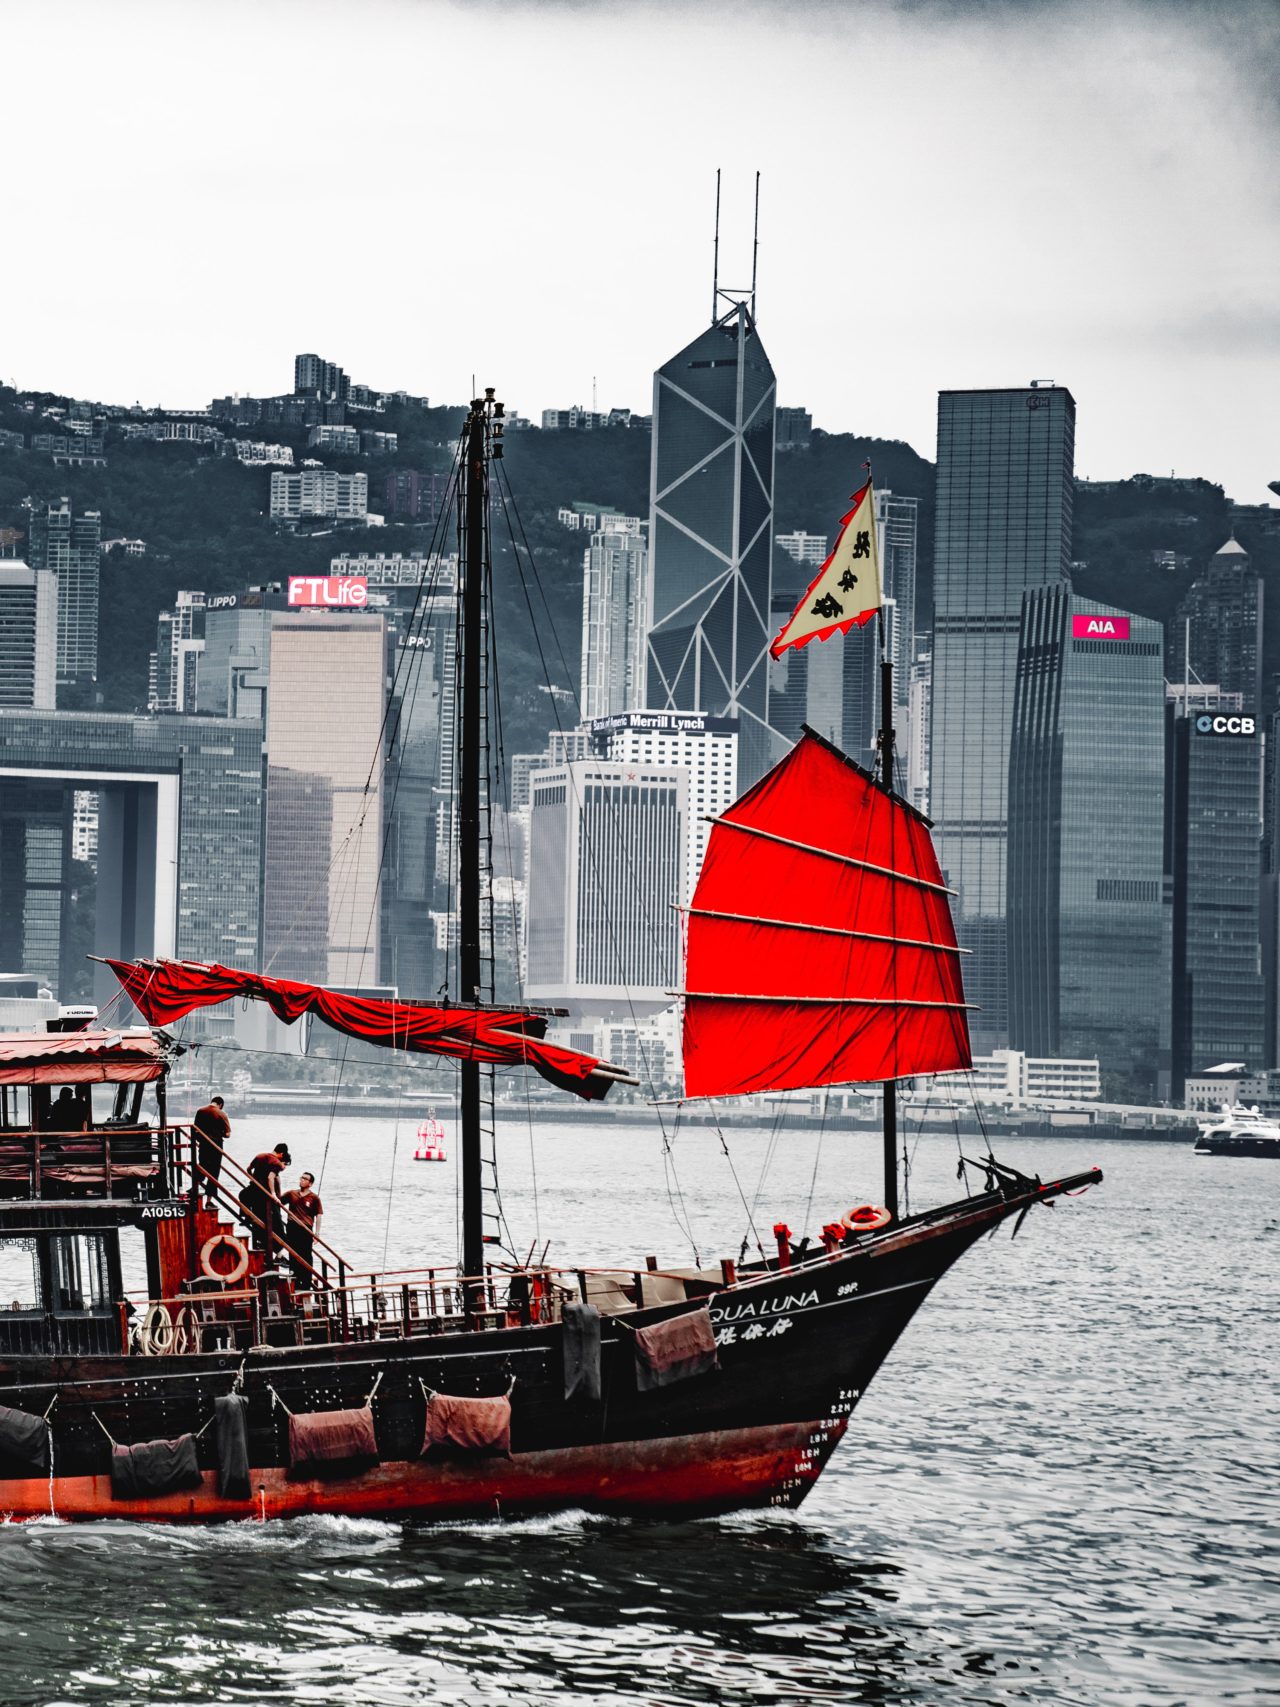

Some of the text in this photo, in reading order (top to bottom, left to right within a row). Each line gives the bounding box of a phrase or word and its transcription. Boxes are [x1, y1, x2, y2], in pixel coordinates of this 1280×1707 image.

[289, 578, 368, 604] FTLife
[207, 595, 237, 608] LIPPO
[1087, 620, 1116, 633] AIA
[630, 714, 668, 728] Merrill
[671, 716, 705, 730] Lynch
[1212, 716, 1255, 734] CCB
[709, 1303, 756, 1324] QUA
[760, 1289, 820, 1315] LUNA
